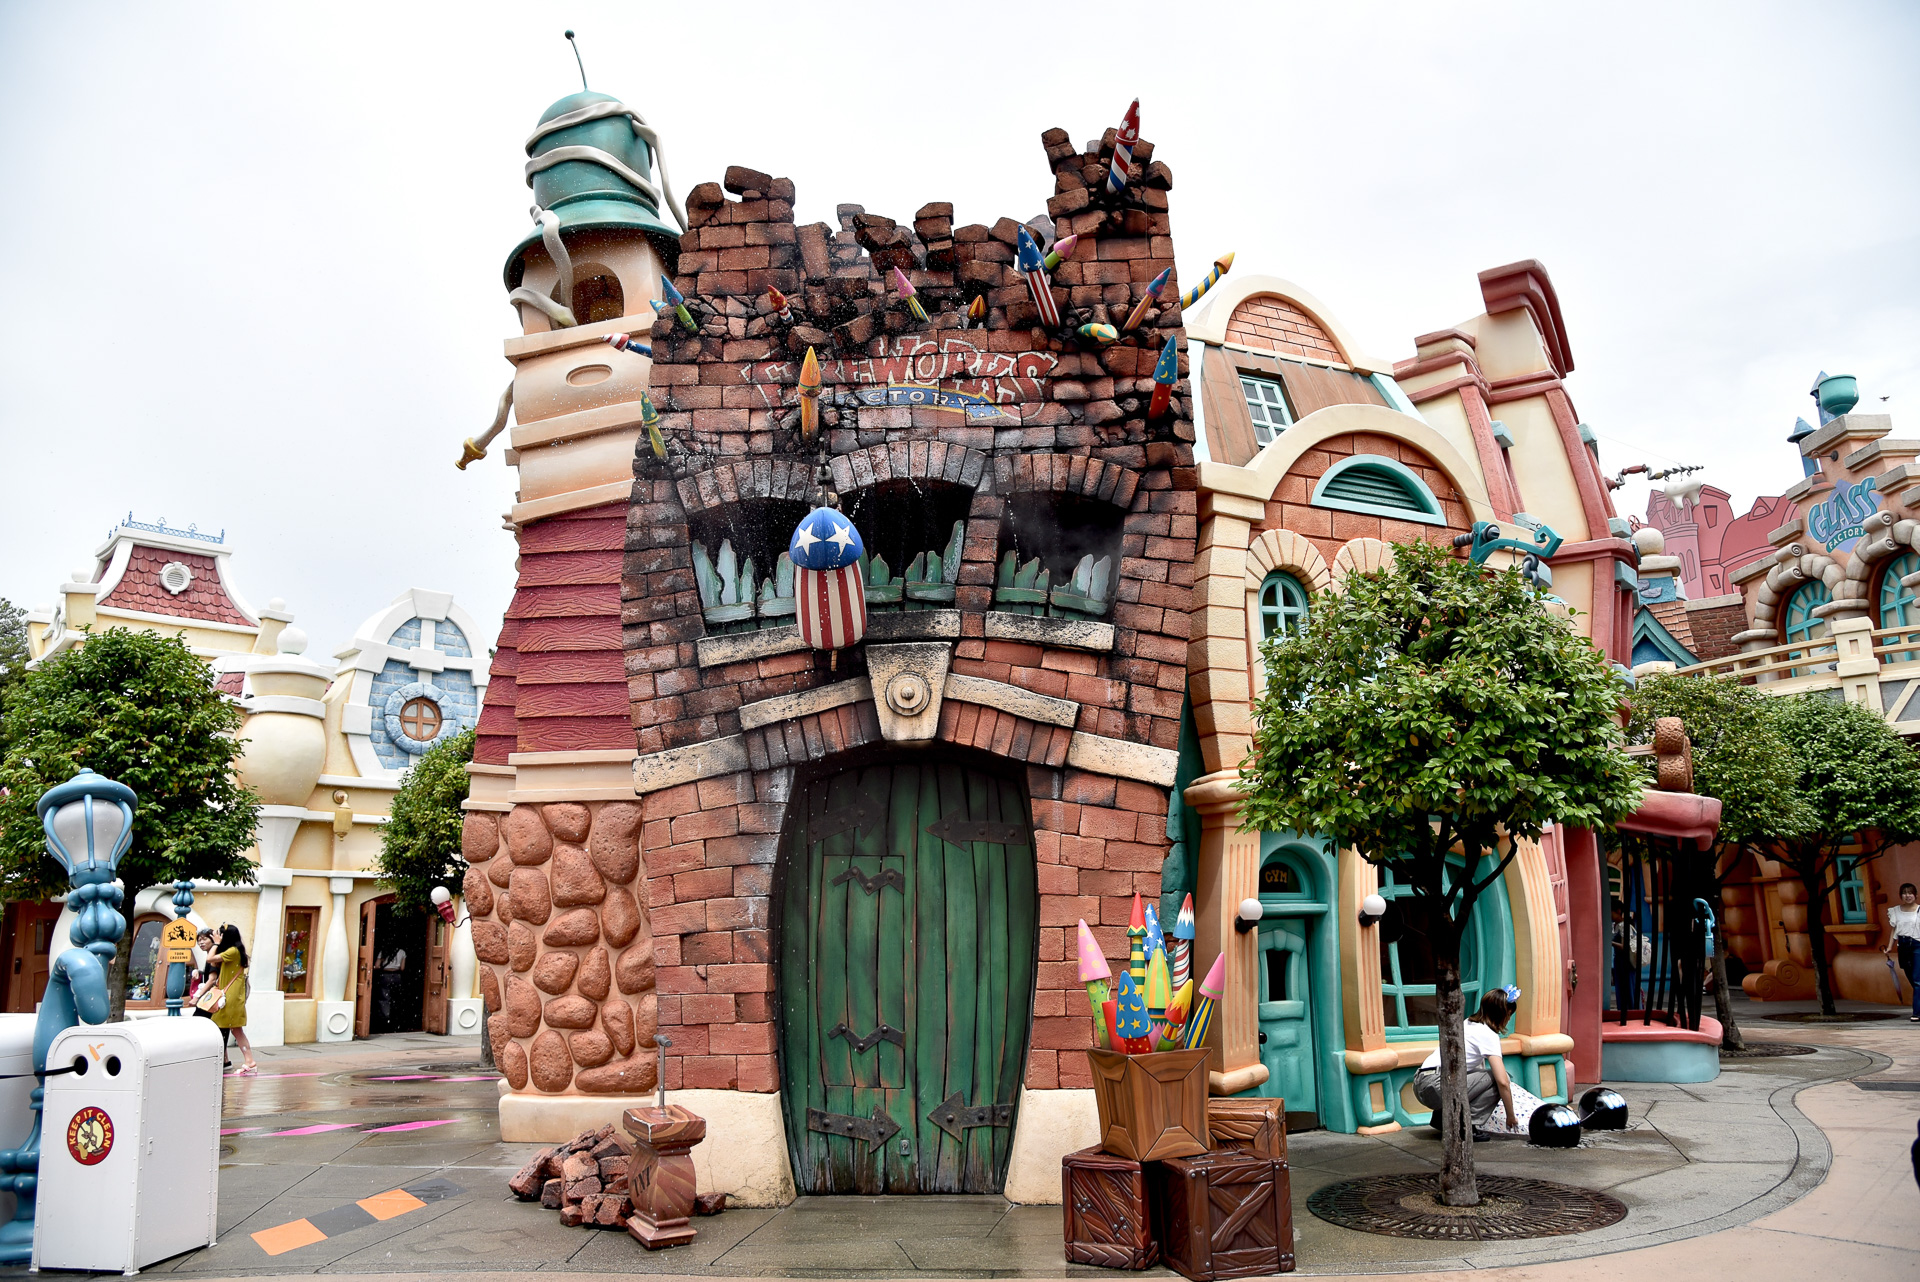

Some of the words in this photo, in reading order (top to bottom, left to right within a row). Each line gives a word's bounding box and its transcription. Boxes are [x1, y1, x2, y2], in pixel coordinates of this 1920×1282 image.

[740, 335, 1058, 429] FREWORKS
[824, 388, 971, 410] ACTORY
[1807, 476, 1877, 543] GLASS
[1828, 527, 1864, 550] FACTORY
[1265, 869, 1287, 883] GYM
[69, 1115, 81, 1145] KEEP
[83, 1109, 93, 1119] IT
[96, 1112, 112, 1148] CLEAN
[633, 1165, 652, 1197] TNT
